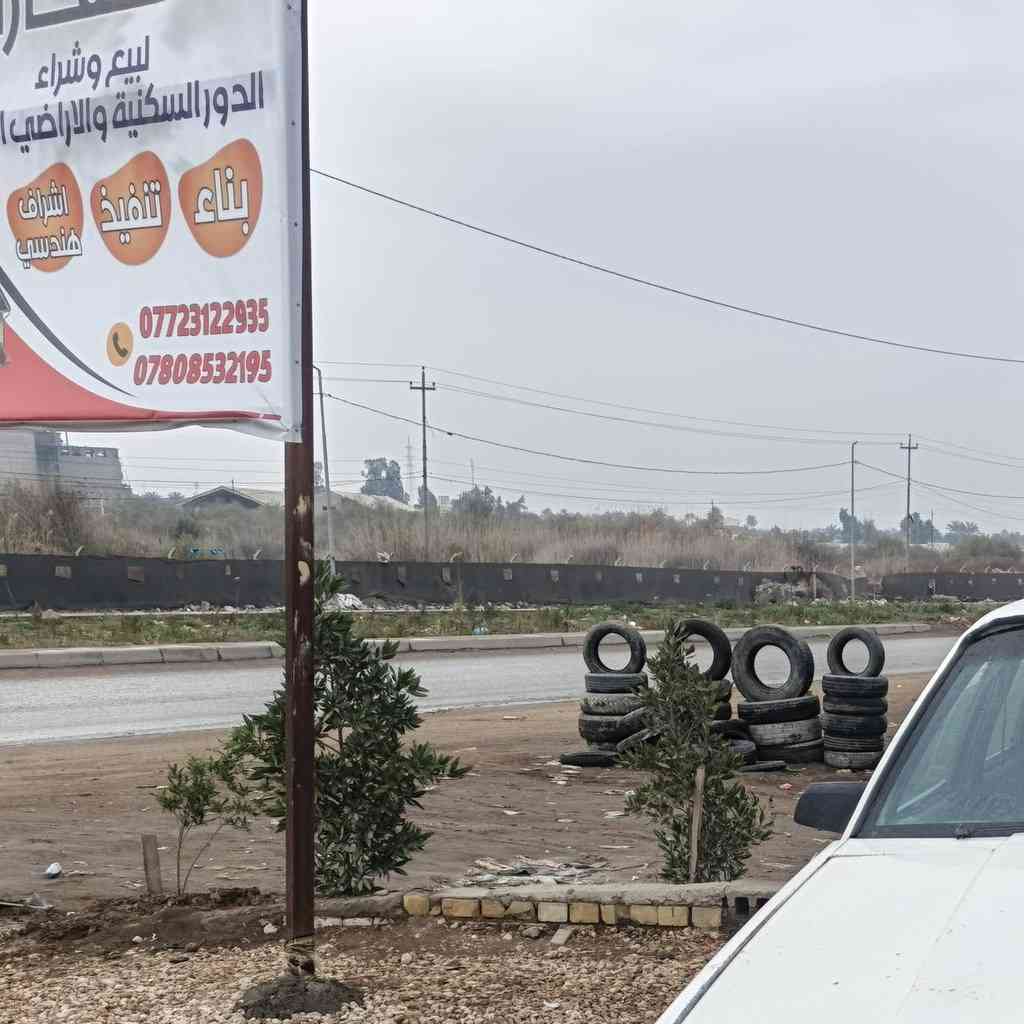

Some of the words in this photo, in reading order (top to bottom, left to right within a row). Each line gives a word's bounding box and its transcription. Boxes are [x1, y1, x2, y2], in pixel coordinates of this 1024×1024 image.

[34, 40, 102, 96] وشراء
[105, 35, 150, 88] لبيع
[9, 97, 107, 153] والاراضي
[112, 80, 201, 138] السكنية
[203, 71, 264, 129] الدور
[18, 179, 69, 227] اشراف
[100, 179, 163, 244] تنفيذ
[193, 166, 250, 235] بناء
[16, 227, 83, 269] هندسي
[139, 298, 269, 339] 07723122935
[133, 350, 272, 385] 07808532195
